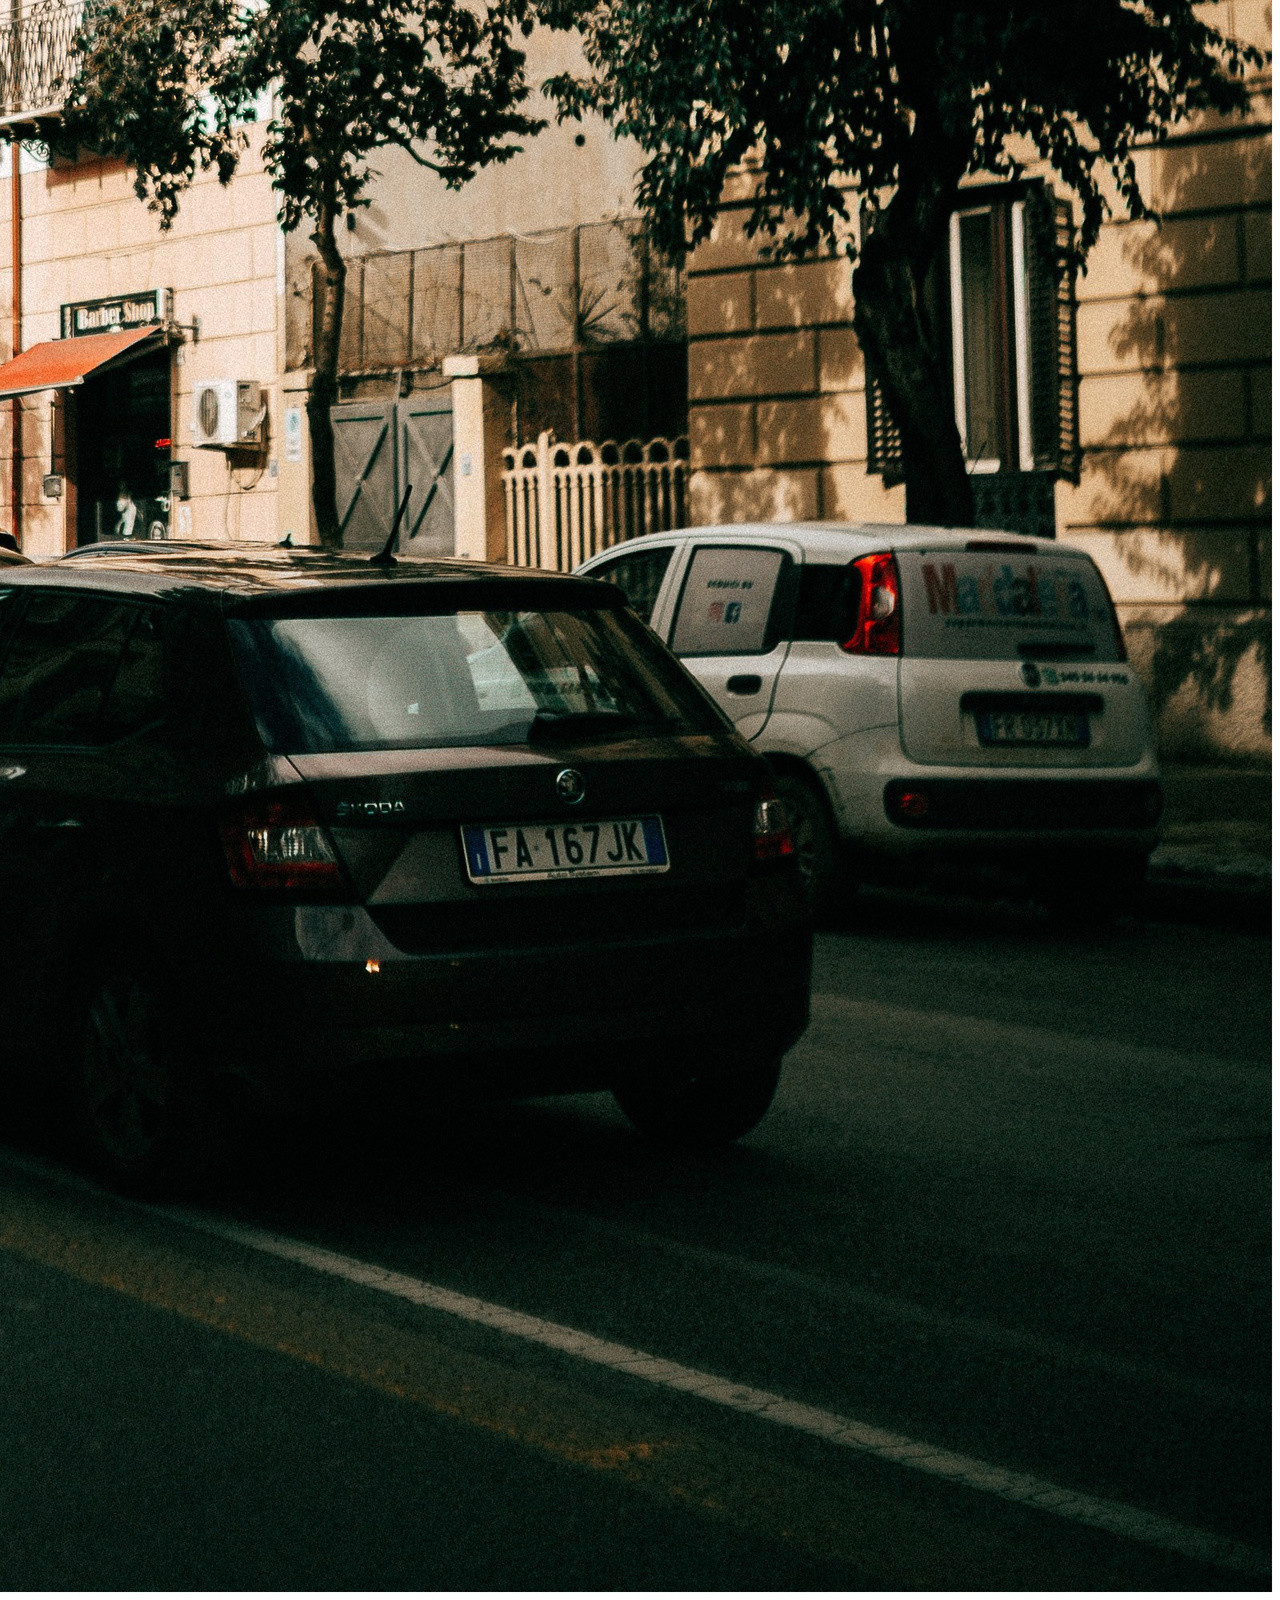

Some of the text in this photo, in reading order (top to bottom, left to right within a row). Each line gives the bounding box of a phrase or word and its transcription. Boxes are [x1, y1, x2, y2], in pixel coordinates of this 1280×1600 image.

[76, 301, 155, 330] Barber Shop
[489, 822, 644, 870] FA 167JK
